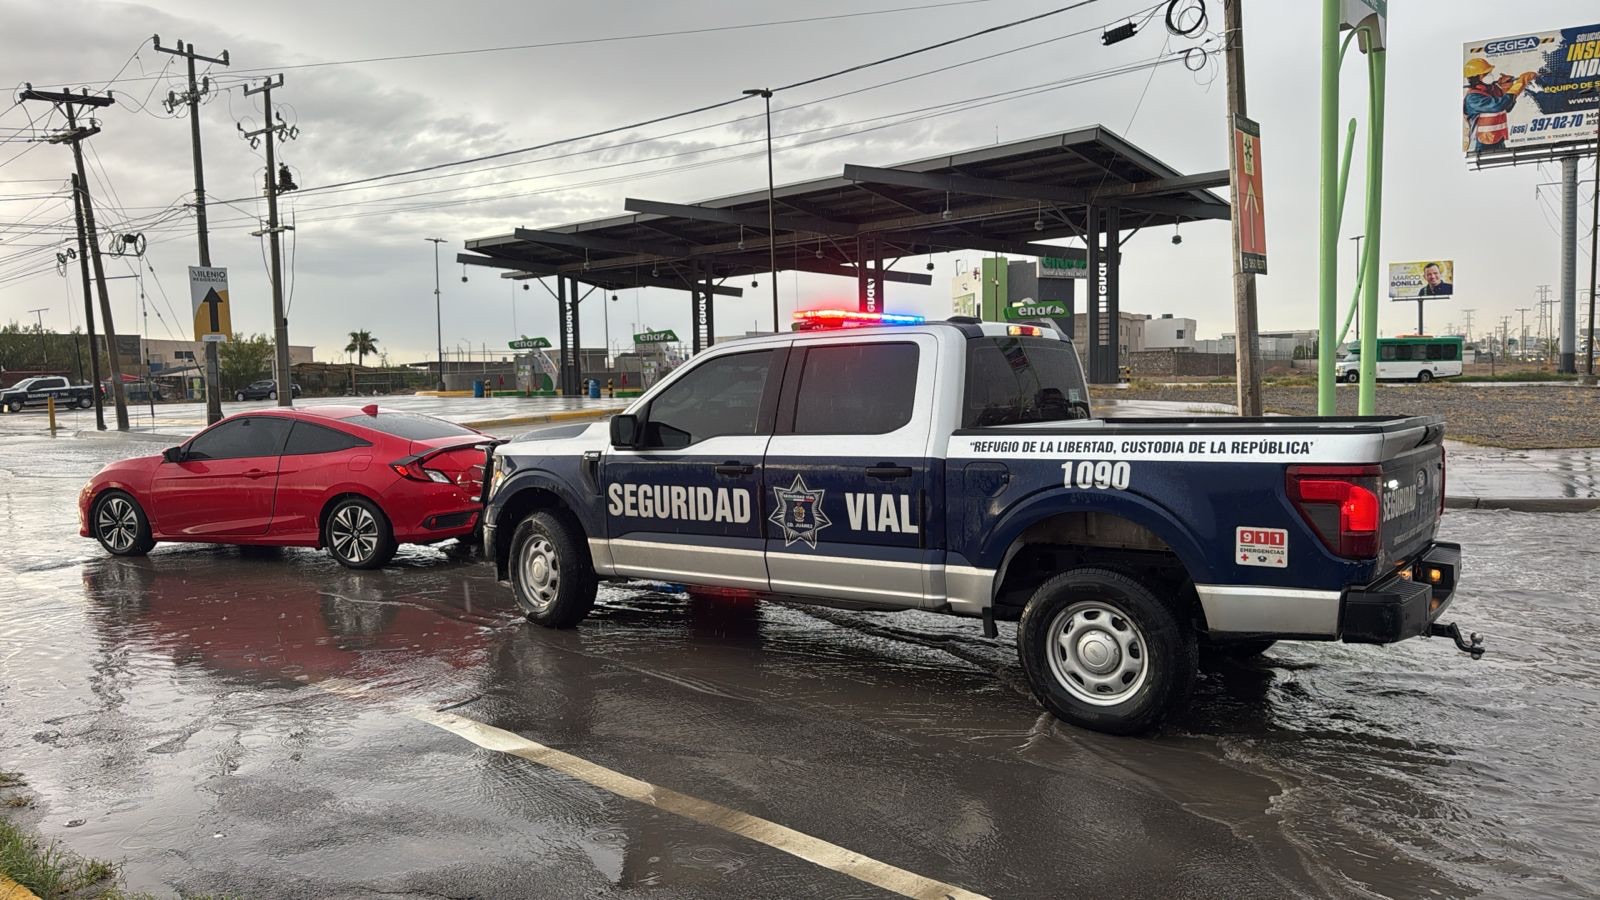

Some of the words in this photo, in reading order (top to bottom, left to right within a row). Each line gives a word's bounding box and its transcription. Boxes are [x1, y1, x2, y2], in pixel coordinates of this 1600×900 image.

[1487, 38, 1536, 53] SEGISA
[1570, 59, 1600, 79] IND
[1544, 82, 1579, 94] EQUIPO
[1580, 81, 1593, 90] DE
[1530, 113, 1584, 132] 397-02-70
[1021, 441, 1037, 453] DE
[1040, 441, 1054, 453] LA
[1057, 441, 1117, 455] LIBERTAD,
[1121, 441, 1184, 454] CUSTODIA
[1188, 441, 1206, 454] DE
[1210, 441, 1227, 454] LA
[1061, 461, 1131, 490] 1090
[608, 482, 750, 524] SEGURIDAD
[845, 492, 919, 534] VIAL
[1243, 532, 1281, 544] 911
